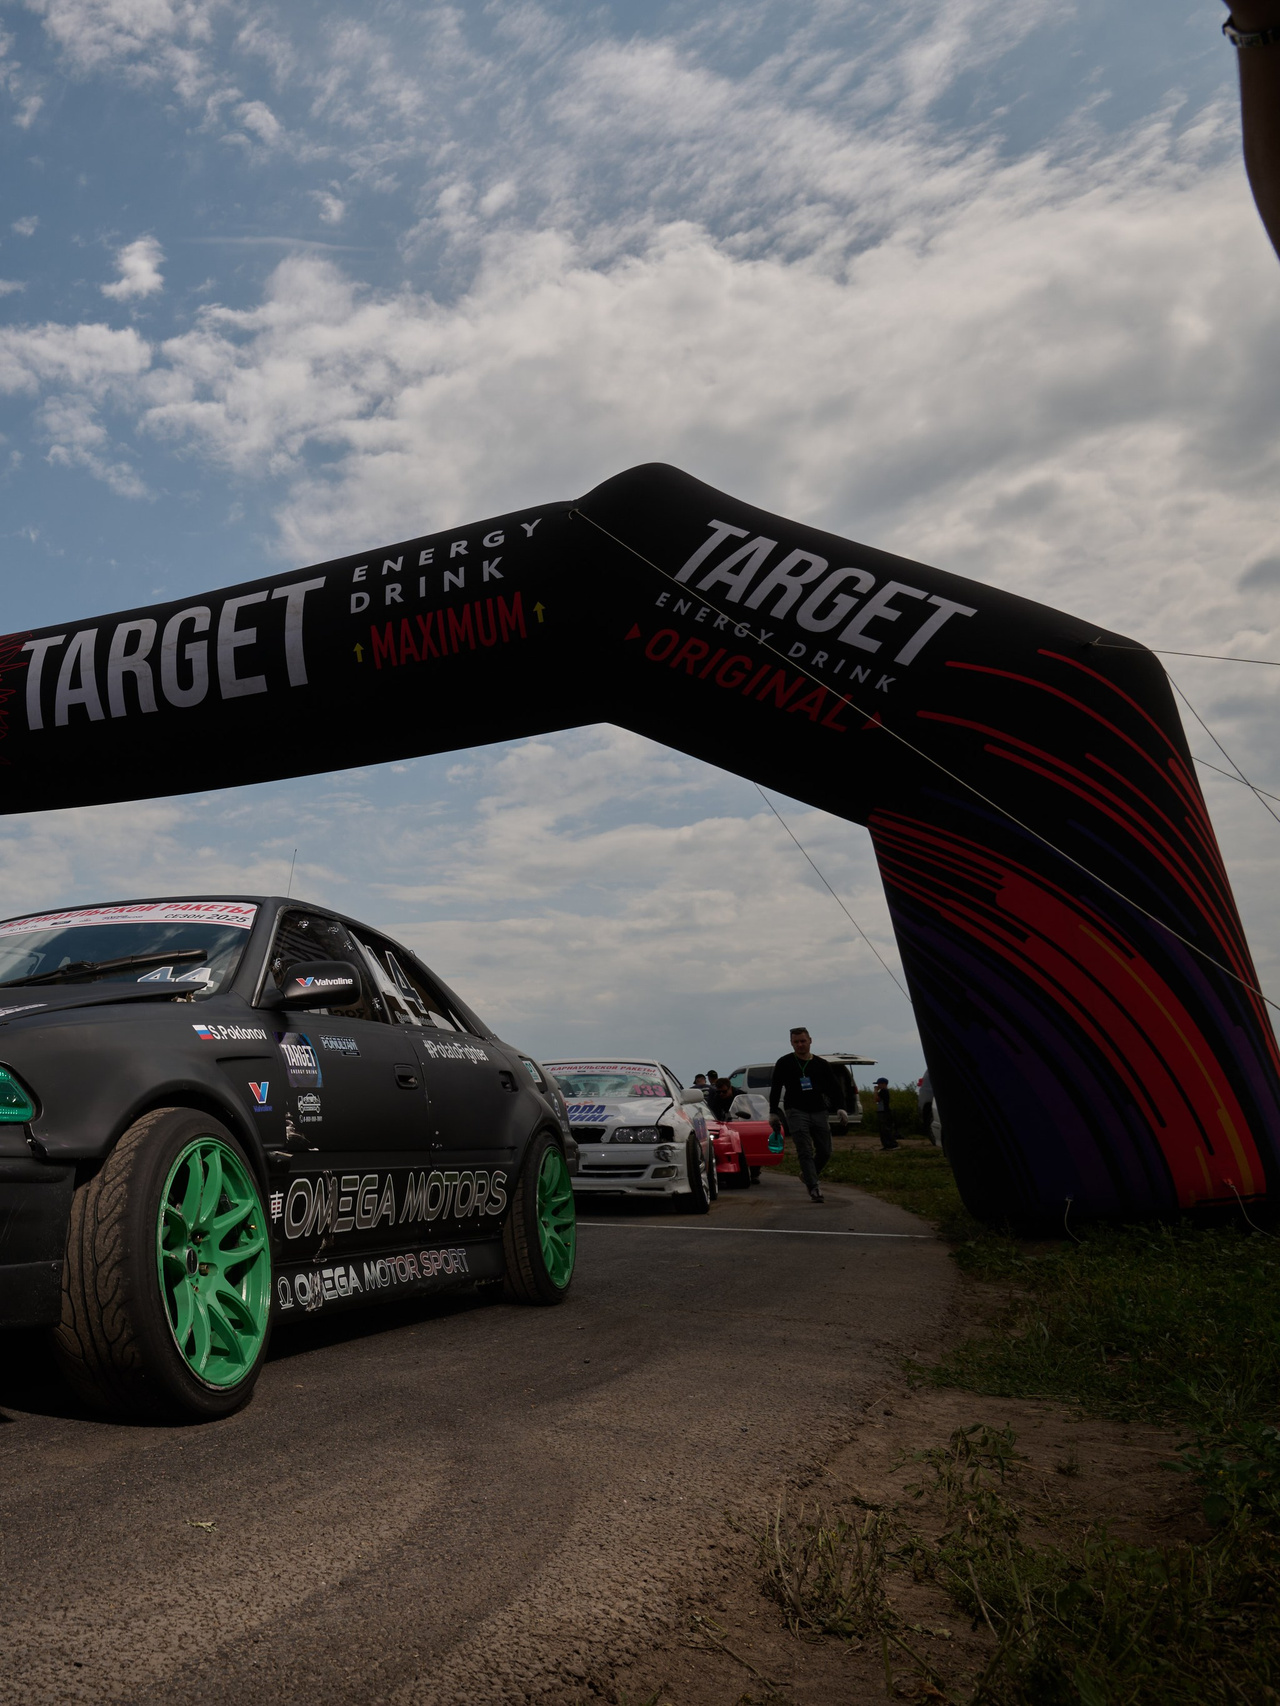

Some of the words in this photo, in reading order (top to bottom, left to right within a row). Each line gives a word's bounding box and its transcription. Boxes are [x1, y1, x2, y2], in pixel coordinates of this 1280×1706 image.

[352, 518, 543, 584] ENERGY
[350, 556, 505, 614] DRINK
[674, 518, 978, 667] TARGET
[21, 576, 326, 731] TARGET
[370, 591, 528, 670] MAXIMUM
[655, 591, 774, 646] ENERGY
[787, 641, 897, 693] DRINK
[644, 628, 854, 733] ORIGINAL
[161, 903, 256, 915] РАКЕТЫ
[210, 913, 250, 923] 2025
[136, 966, 214, 991] 44
[314, 977, 354, 987] Valvoline
[208, 1025, 268, 1040] S.Poklonov
[281, 1044, 317, 1067] TARGET
[423, 1040, 489, 1064] #PotatoFighter
[284, 1173, 396, 1239] OMEGA
[399, 1170, 508, 1224] MOTORS
[294, 1265, 363, 1306] OMEGA
[363, 1252, 421, 1291] MOTOR
[420, 1248, 469, 1277] SPORT
